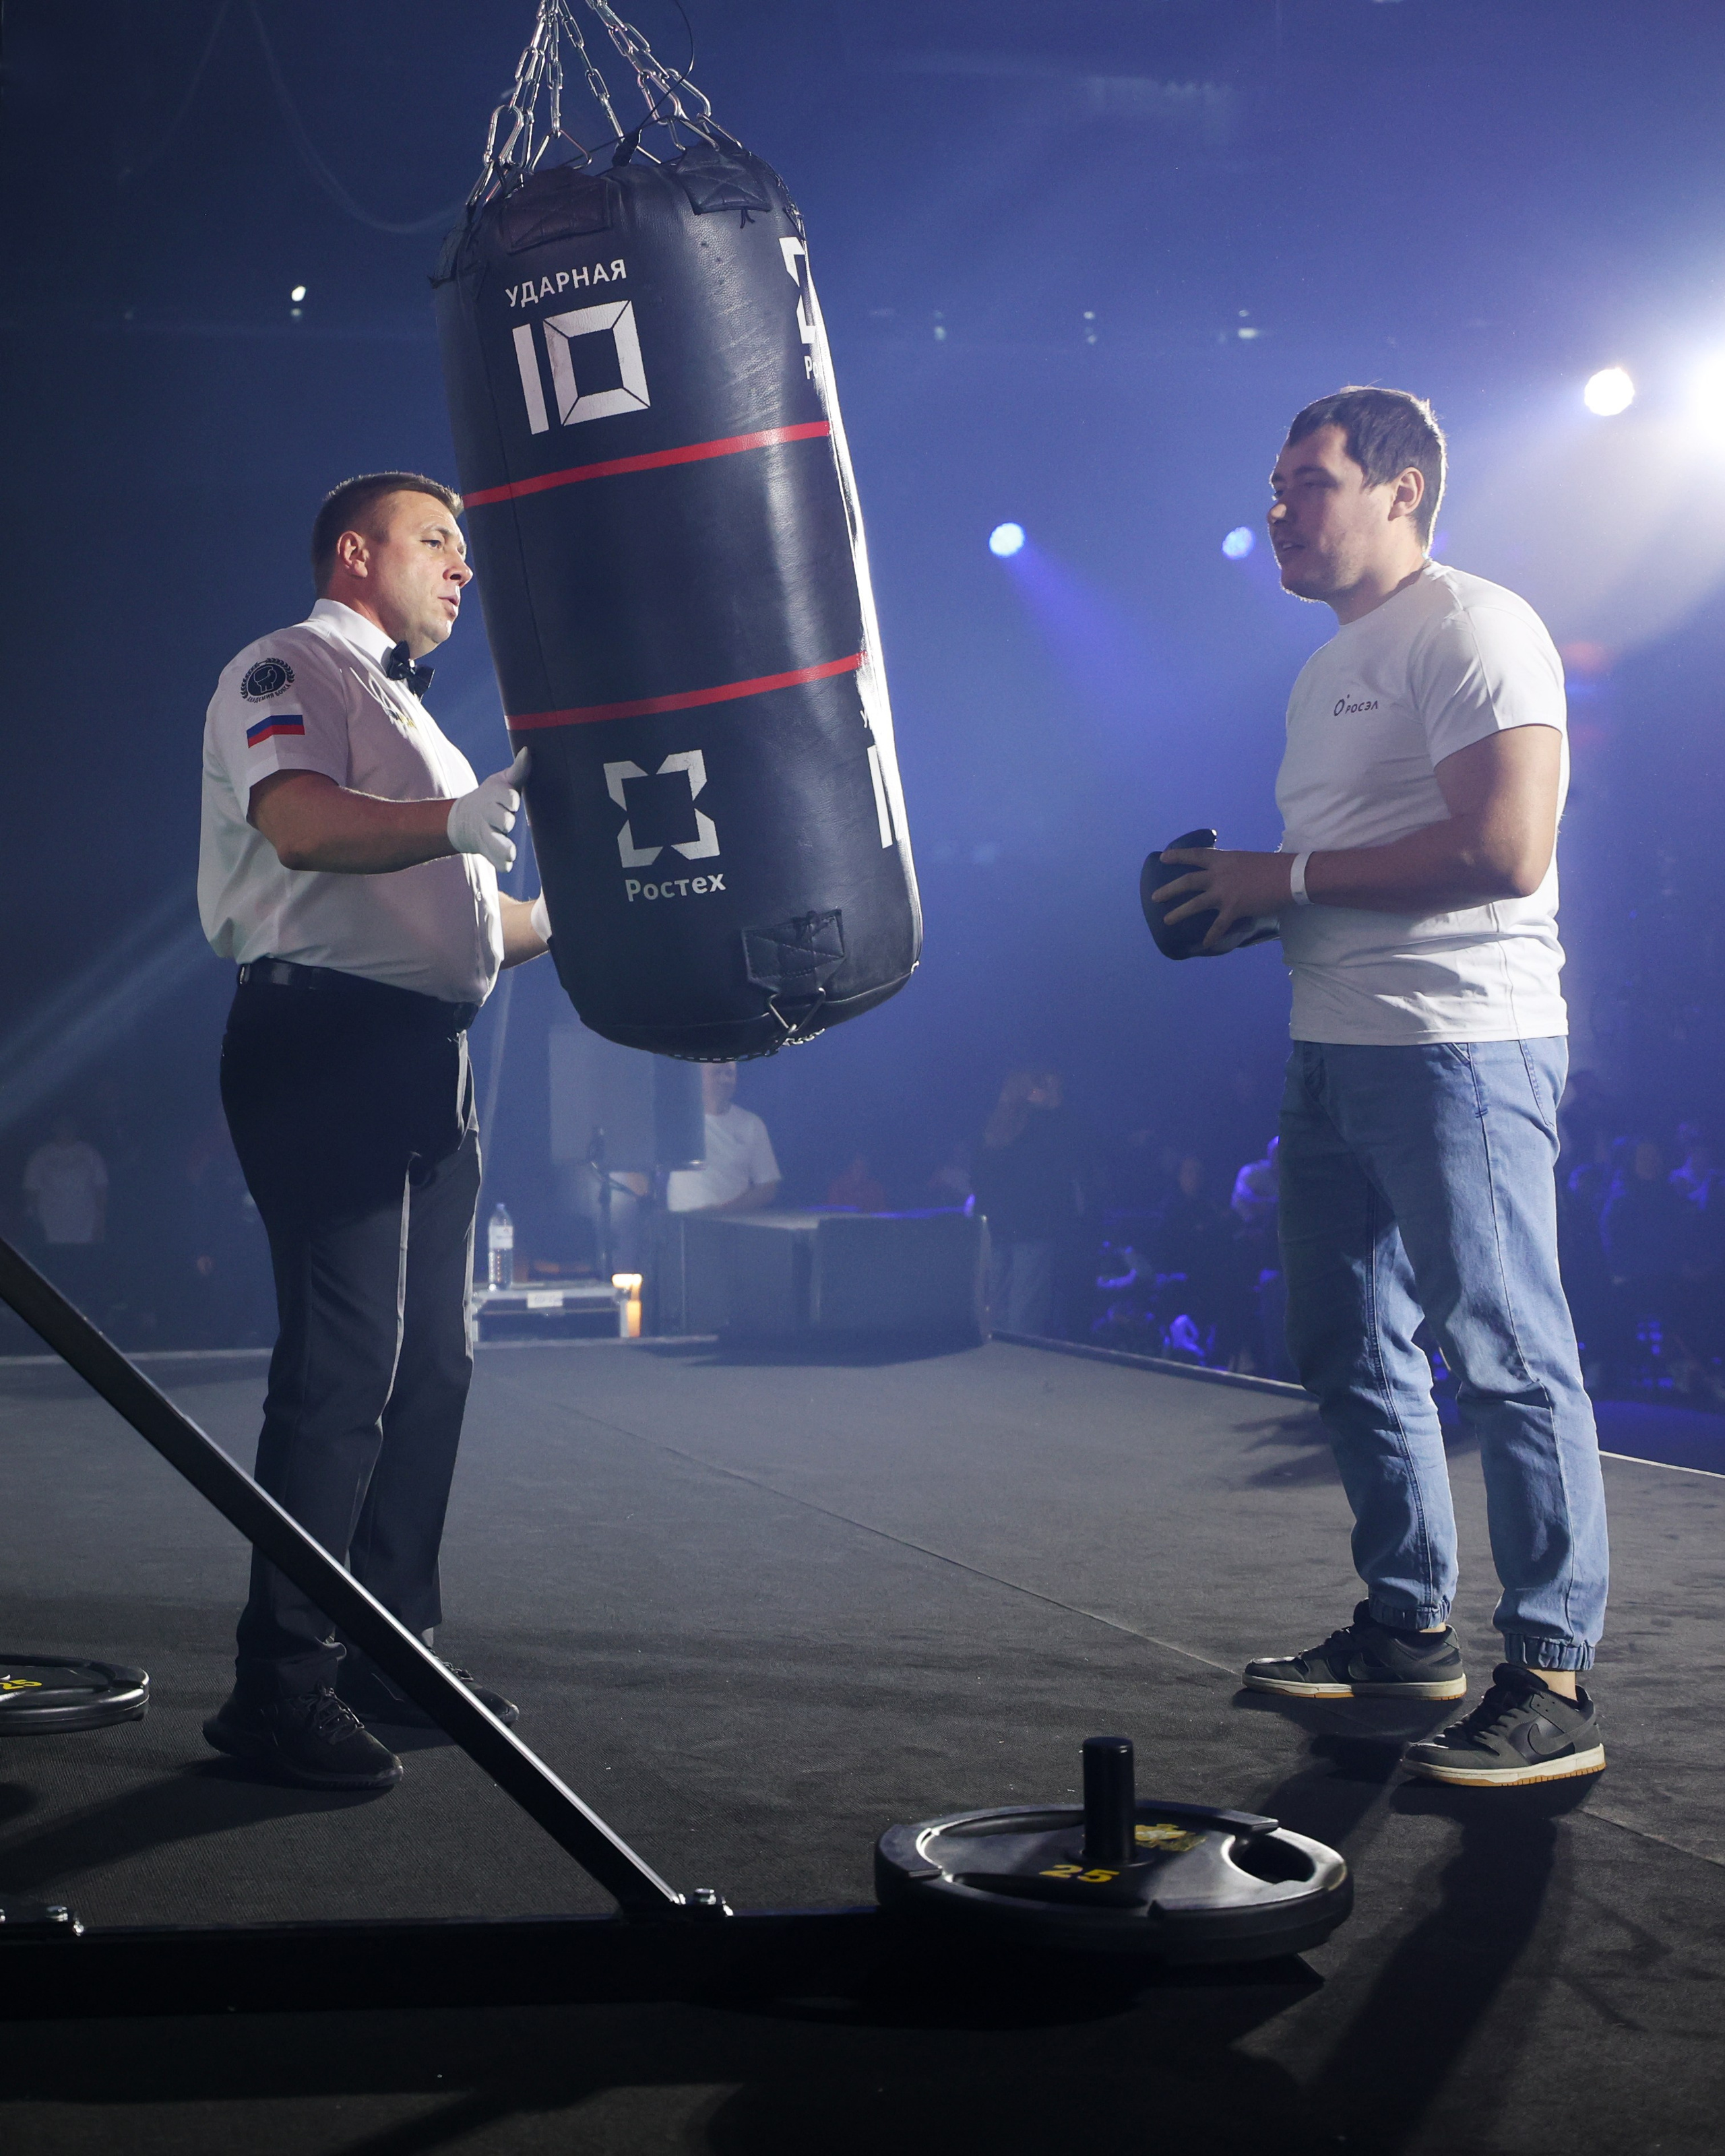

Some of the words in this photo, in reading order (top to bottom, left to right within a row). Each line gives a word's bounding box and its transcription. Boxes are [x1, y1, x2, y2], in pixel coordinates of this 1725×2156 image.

[505, 259, 627, 309] УДАРНАЯ
[1345, 700, 1379, 714] РОСЭЛ
[625, 874, 726, 902] Ростех
[1038, 1864, 1120, 1882] 25
